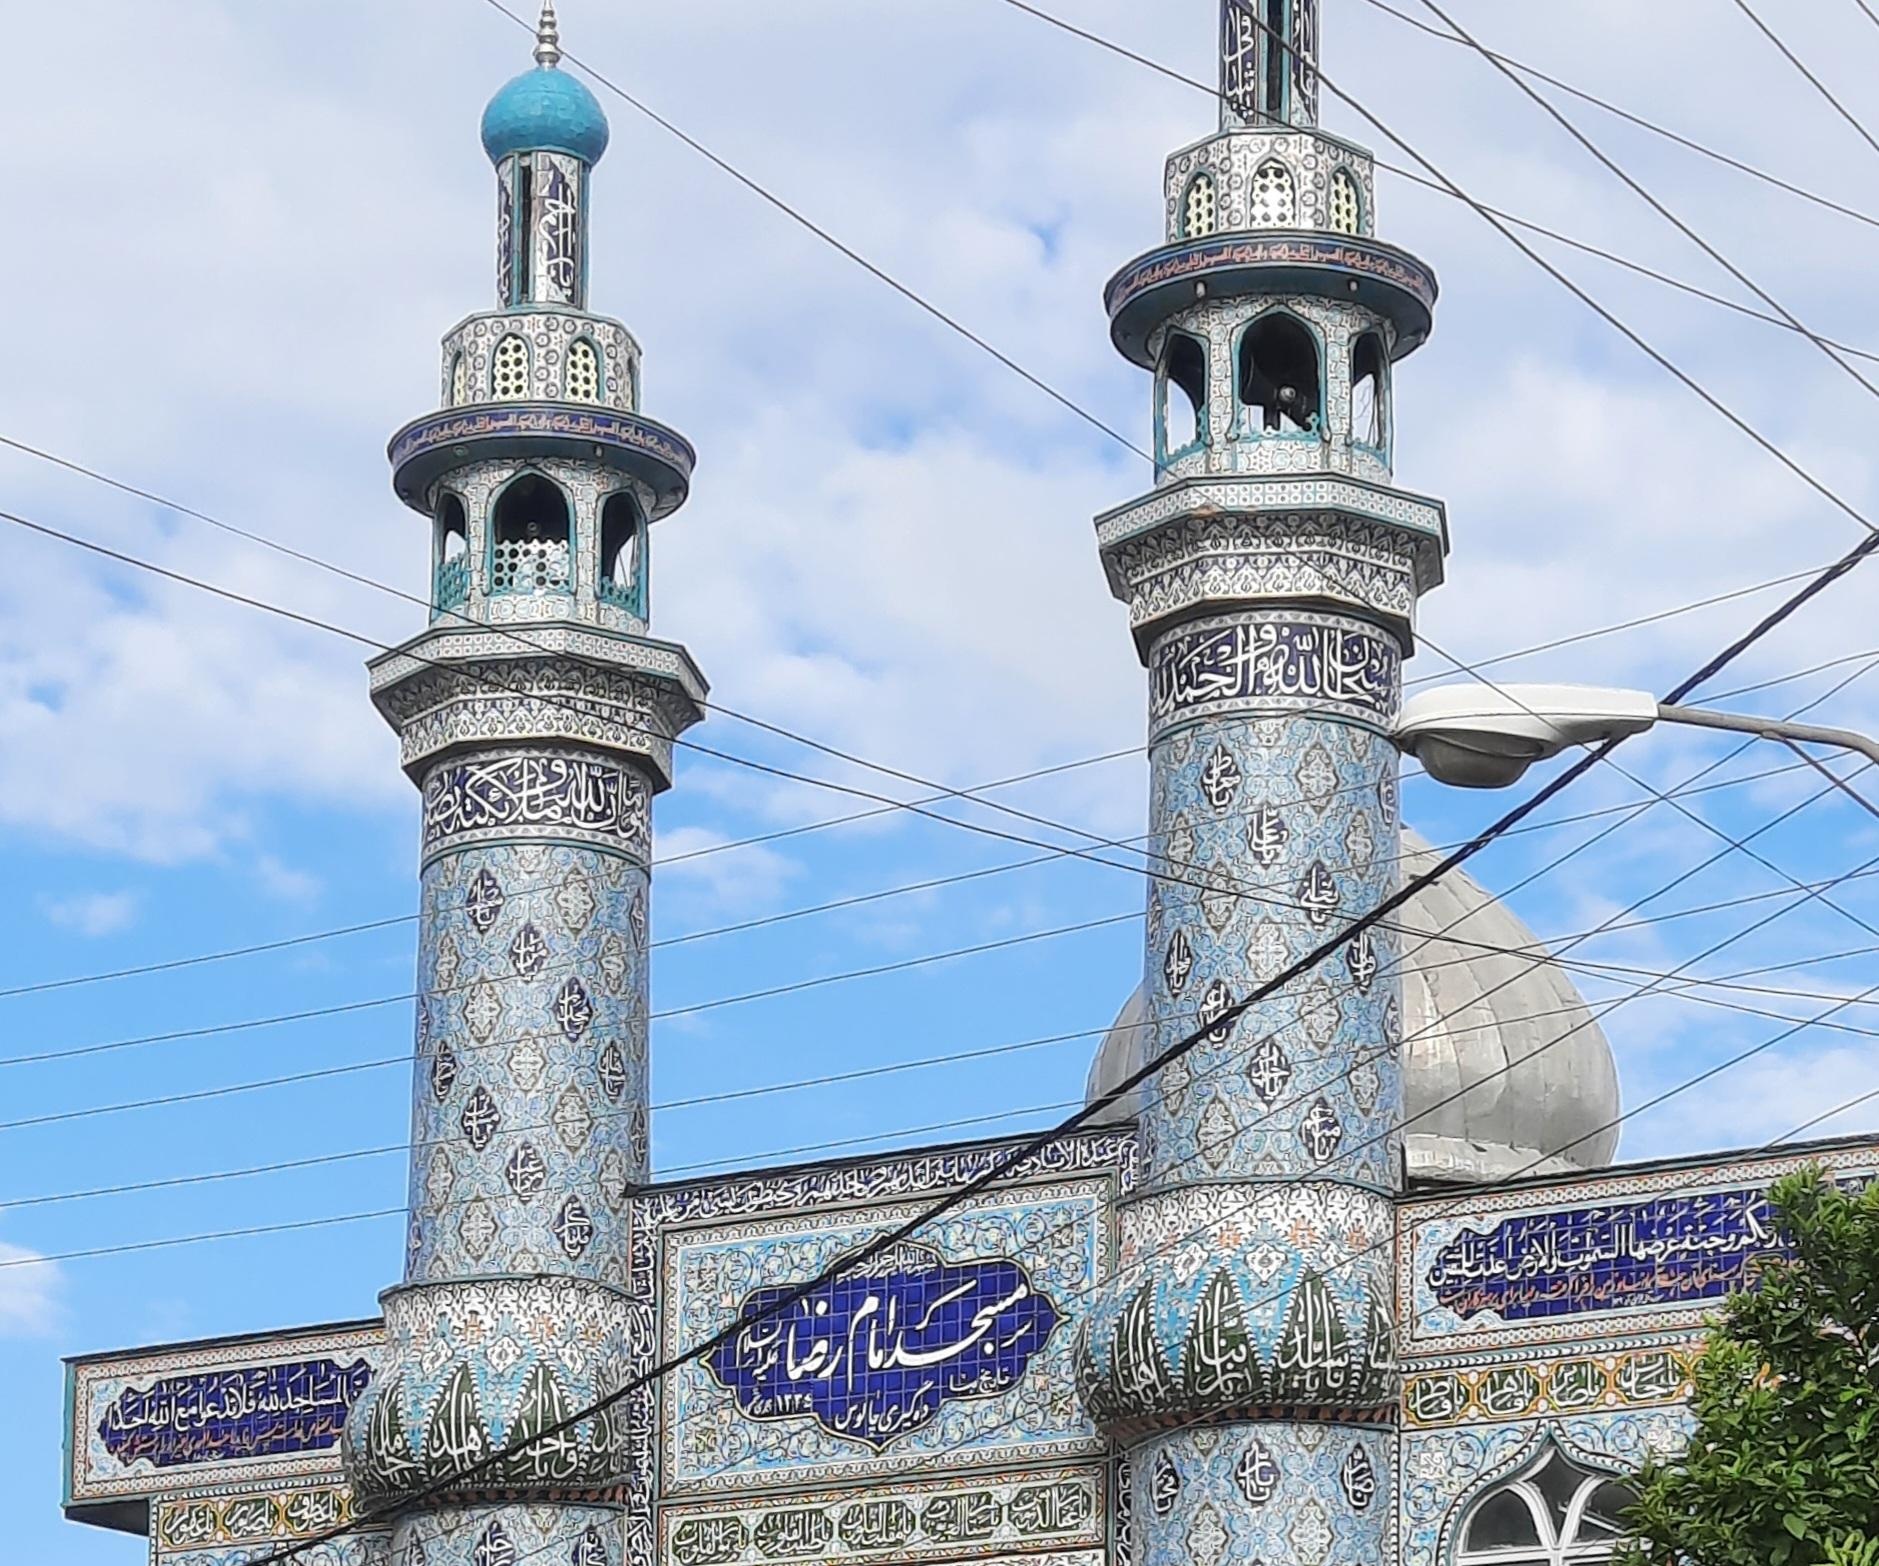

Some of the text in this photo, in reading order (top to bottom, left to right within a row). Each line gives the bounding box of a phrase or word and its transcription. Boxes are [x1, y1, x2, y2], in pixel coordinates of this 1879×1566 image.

[786, 1298, 842, 1380] رضا
[848, 1295, 897, 1391] امام
[887, 1281, 1028, 1368] مسجد
